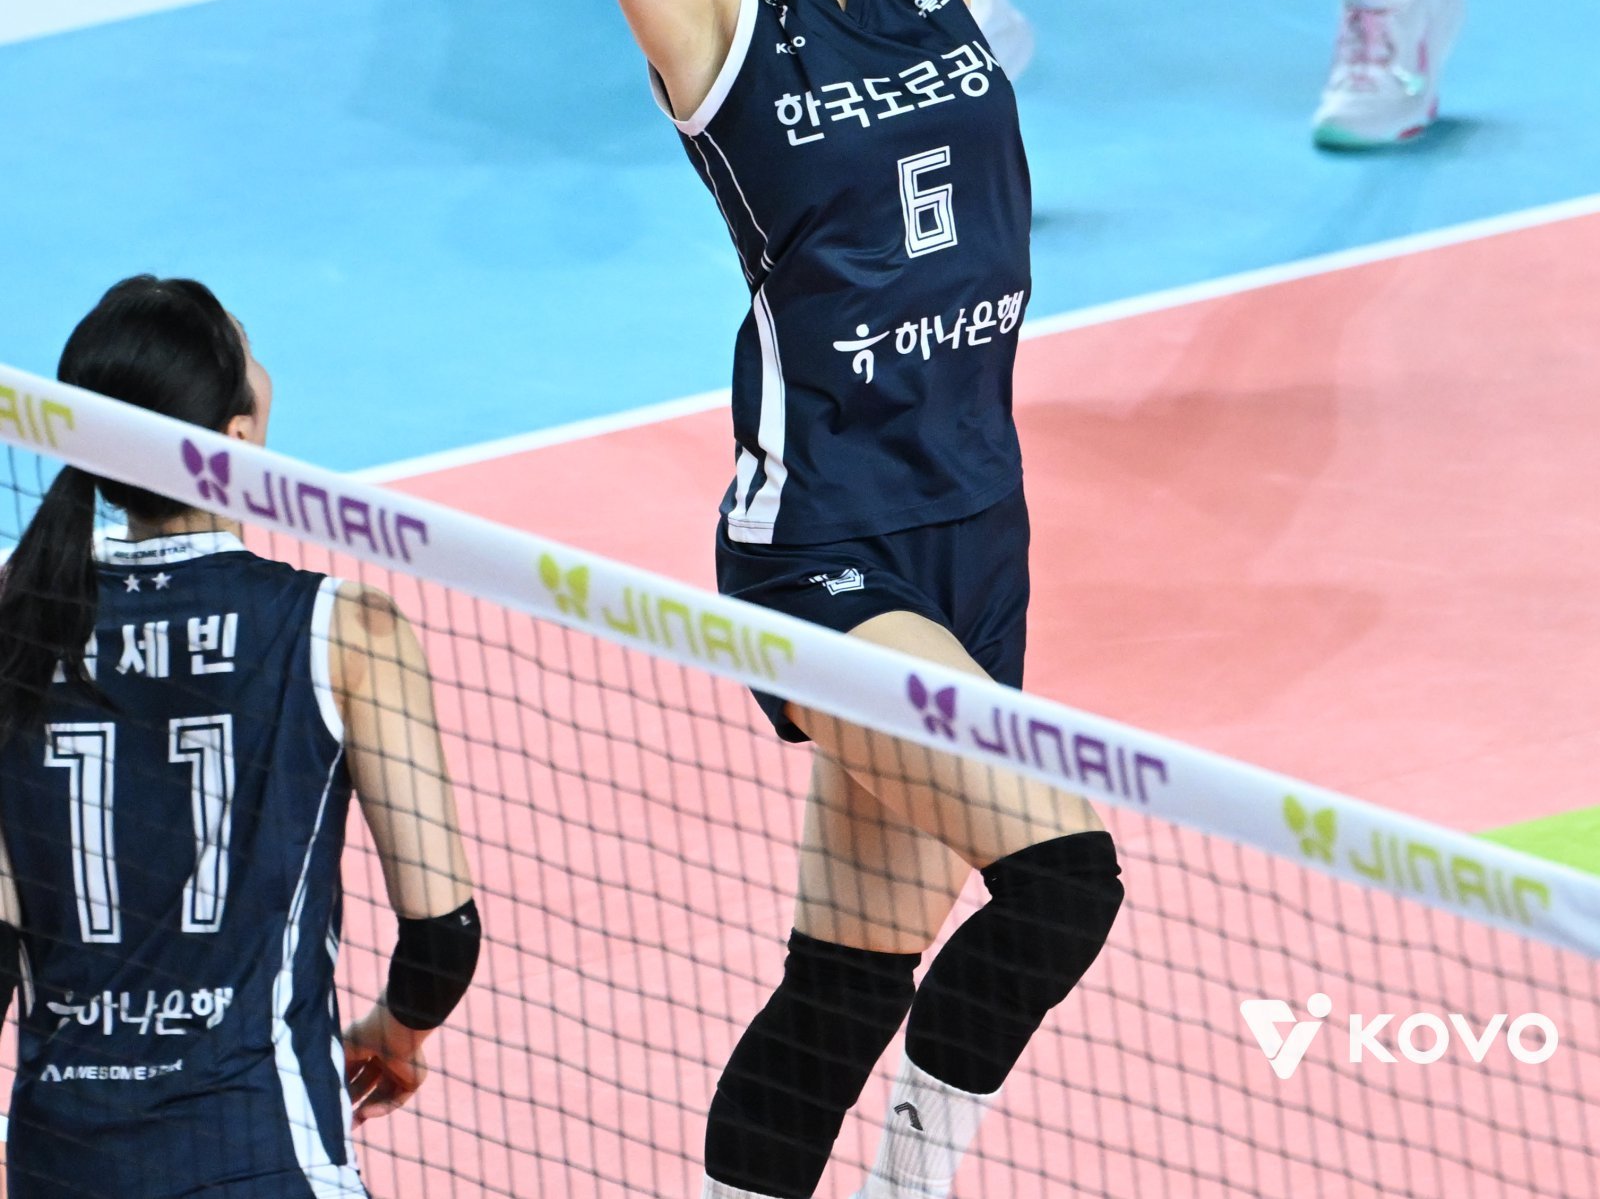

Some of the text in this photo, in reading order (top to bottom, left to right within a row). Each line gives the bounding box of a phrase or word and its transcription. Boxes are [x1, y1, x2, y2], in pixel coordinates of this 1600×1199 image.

[896, 145, 958, 259] 6
[895, 290, 1025, 360] 하나은행
[243, 470, 429, 564] JINAIR
[602, 586, 796, 682] JINAIR
[970, 706, 1170, 805] JINAIR
[44, 714, 236, 944] 11
